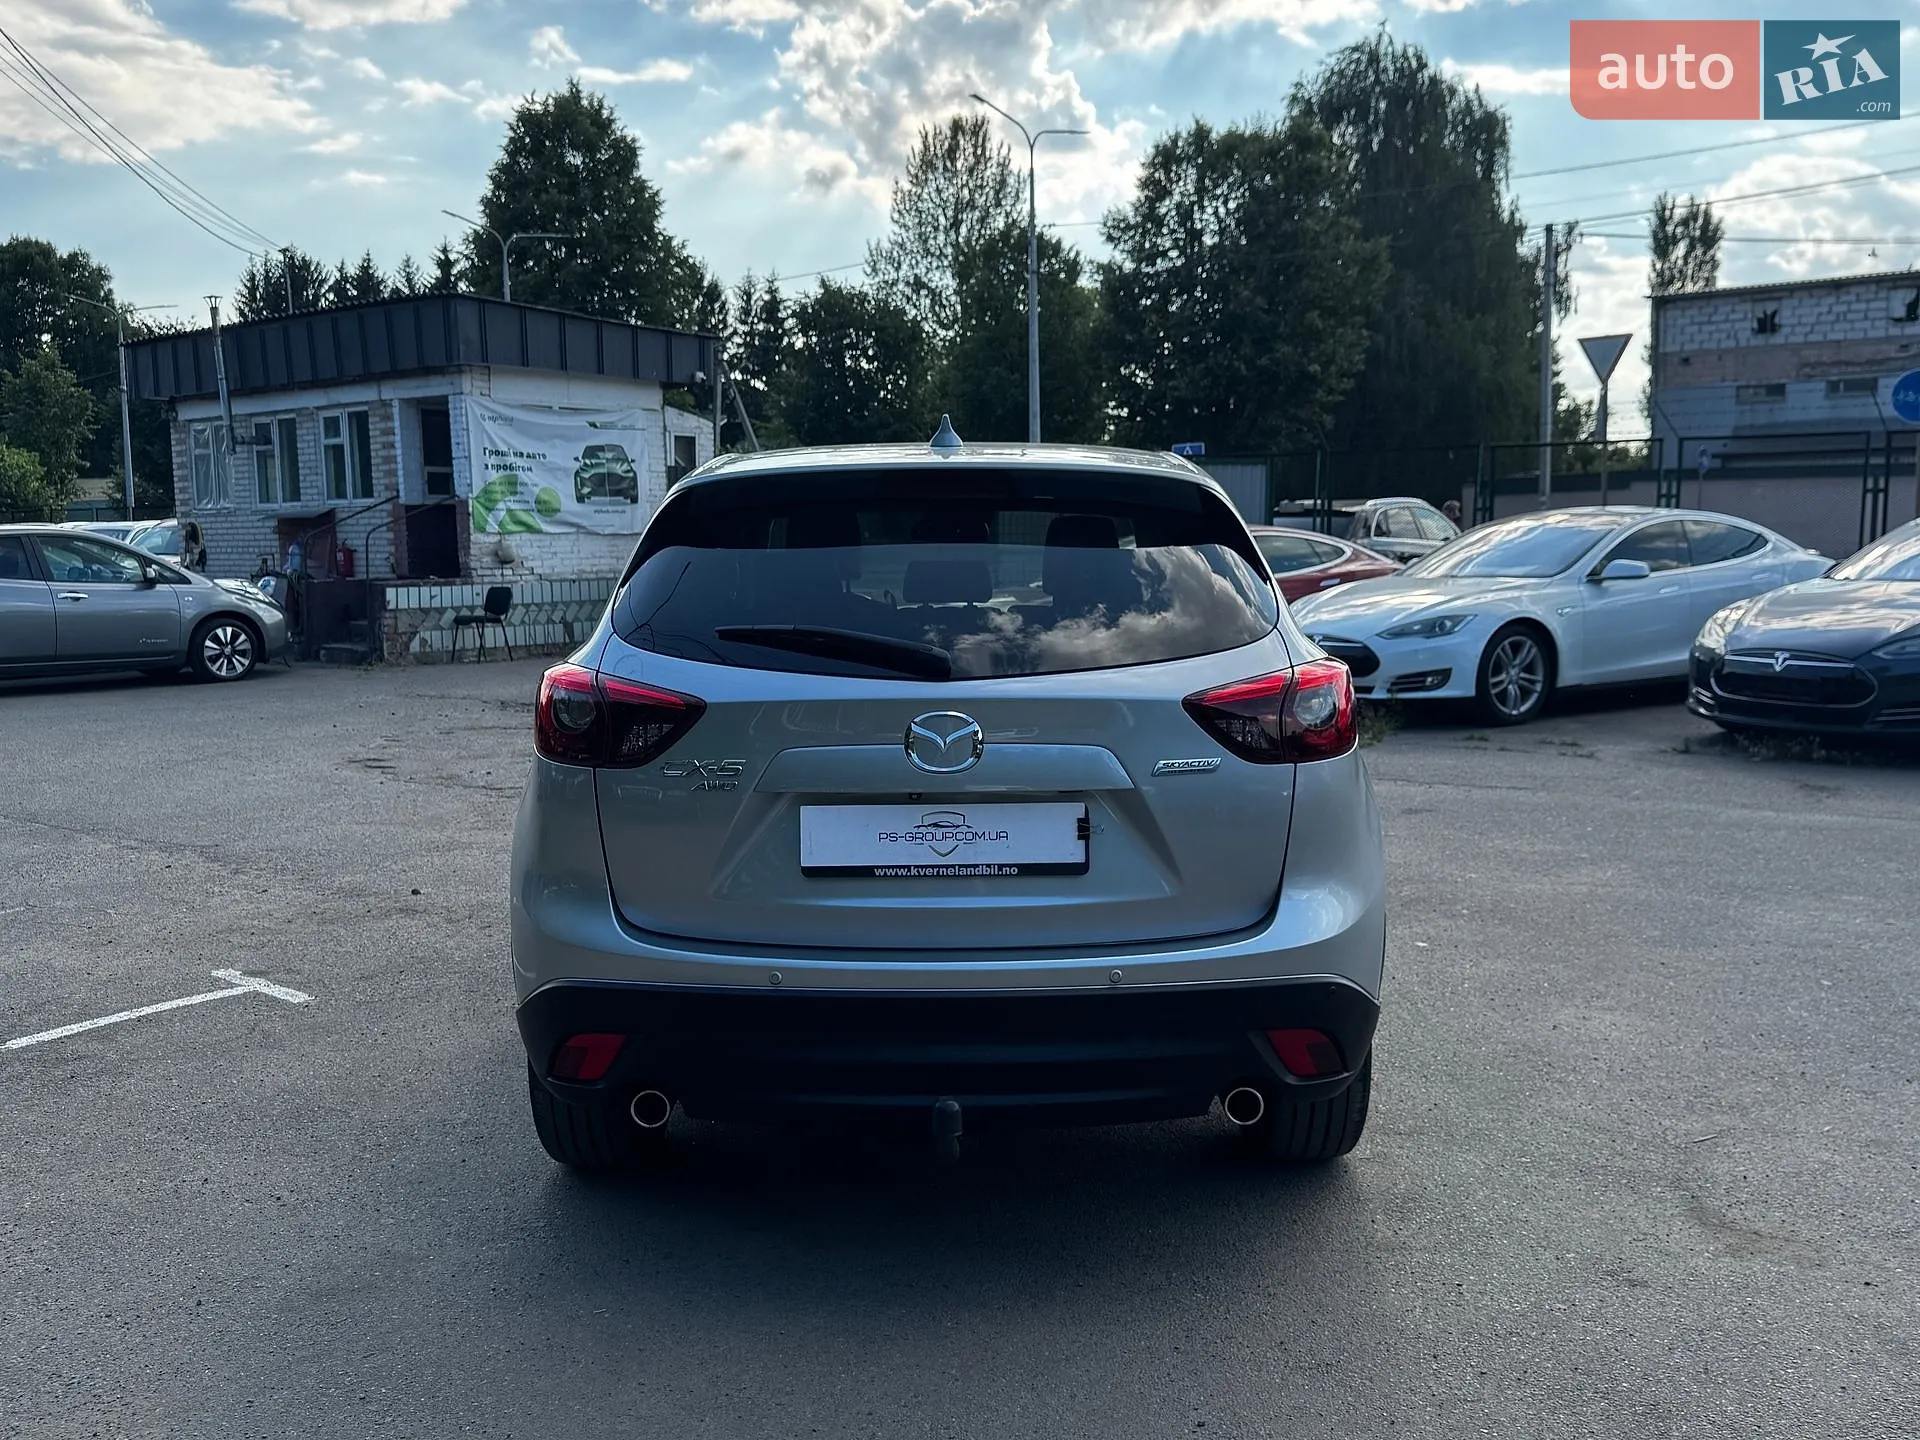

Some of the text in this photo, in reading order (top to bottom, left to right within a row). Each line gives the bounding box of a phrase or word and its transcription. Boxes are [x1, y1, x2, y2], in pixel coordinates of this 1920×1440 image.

[483, 447, 512, 459] Гроші
[526, 451, 547, 460] авто
[491, 461, 533, 473] пробігом
[663, 759, 746, 777] CX-5
[1162, 760, 1217, 769] SKYACTIV
[878, 830, 1009, 843] PS-GROUP.COM.UA
[874, 865, 1019, 877] www.kvernelandbil.no
